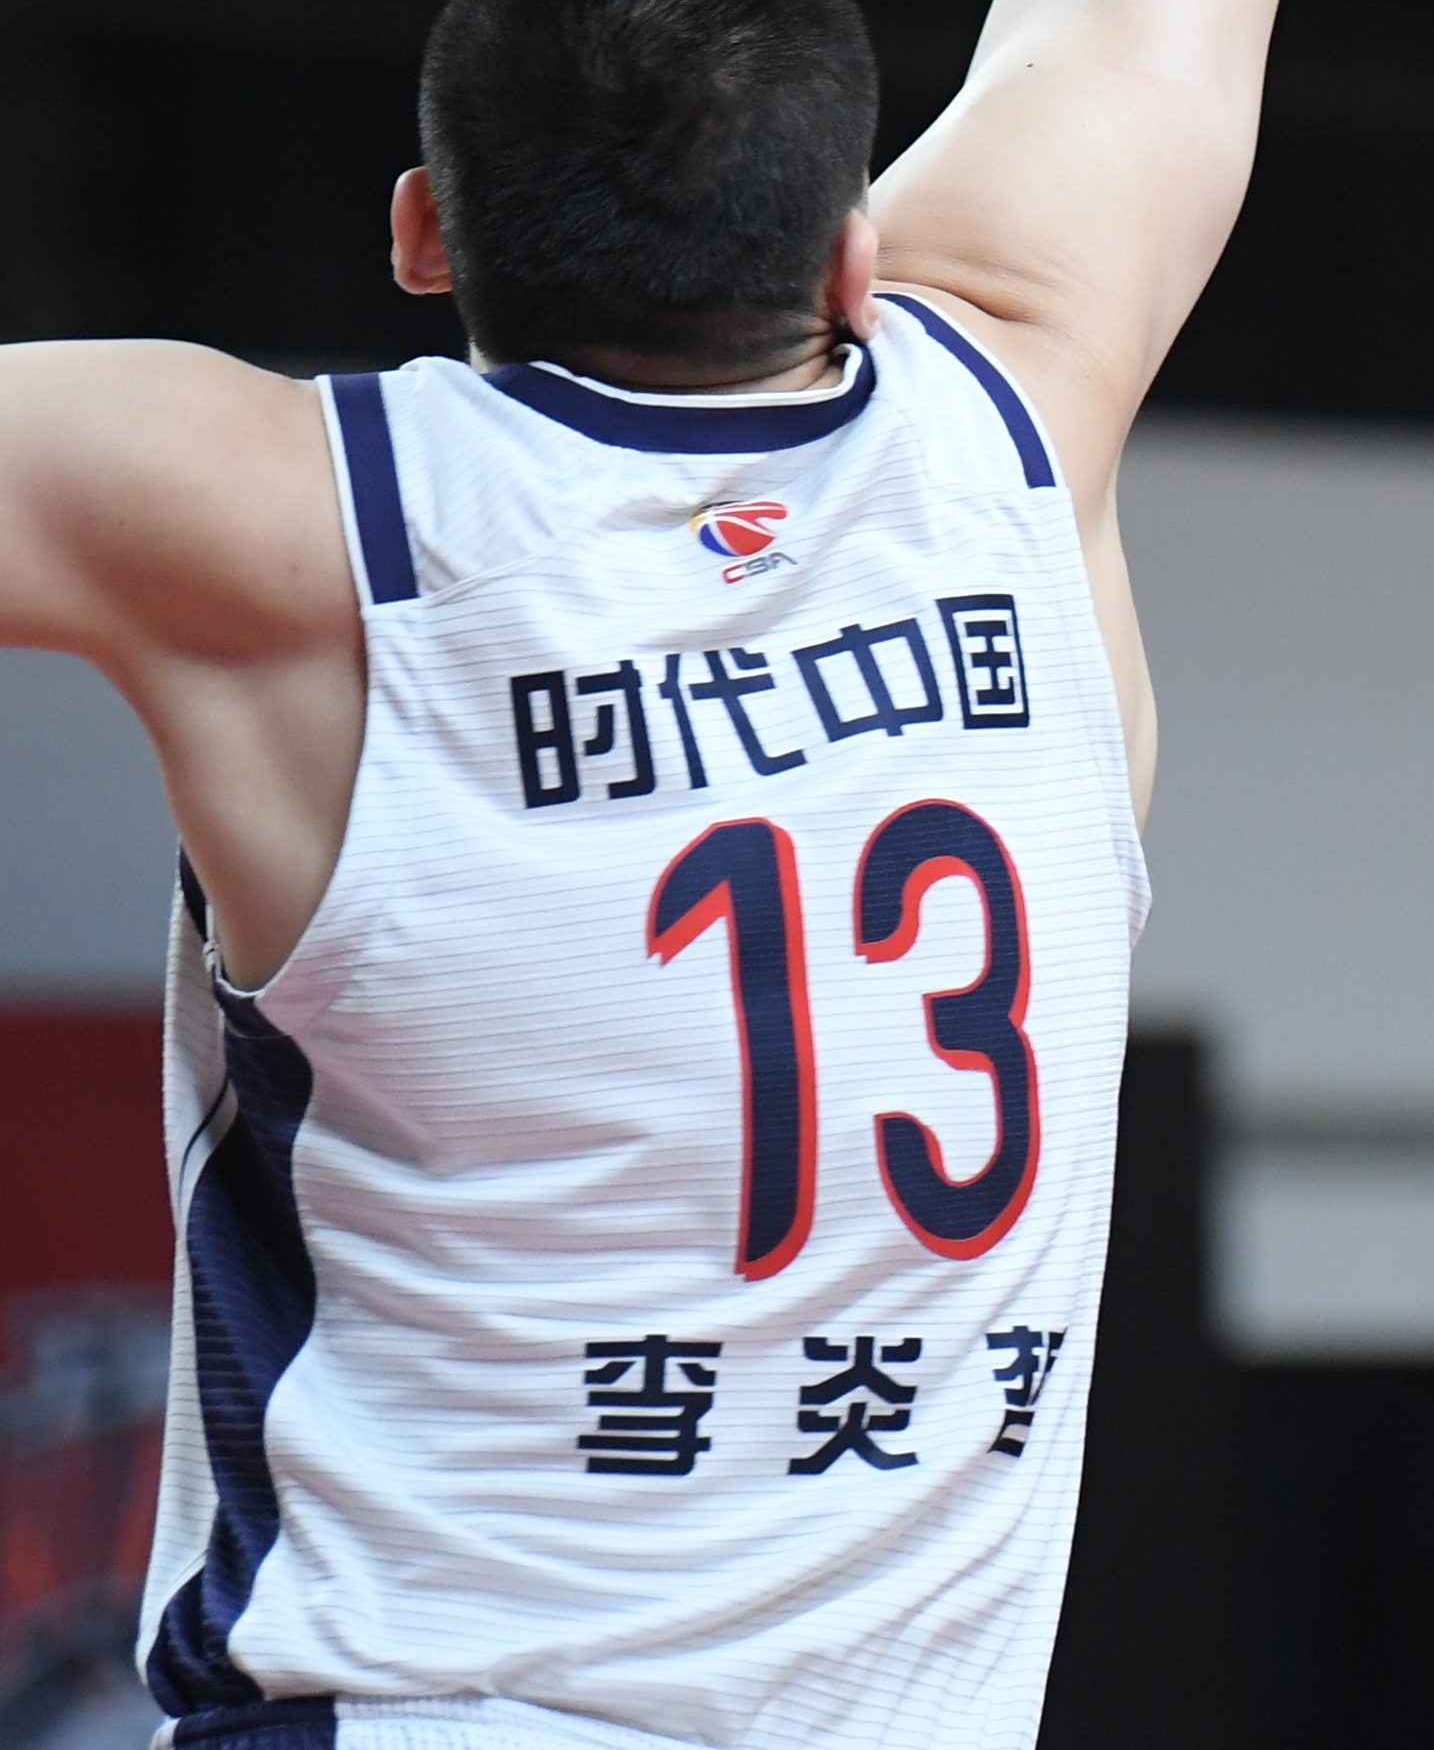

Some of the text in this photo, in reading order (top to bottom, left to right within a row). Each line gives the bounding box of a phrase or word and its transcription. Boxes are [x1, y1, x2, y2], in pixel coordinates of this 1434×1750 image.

[722, 551, 798, 584] CBA
[511, 594, 1029, 808] 时代中国
[646, 798, 1041, 1282] 13
